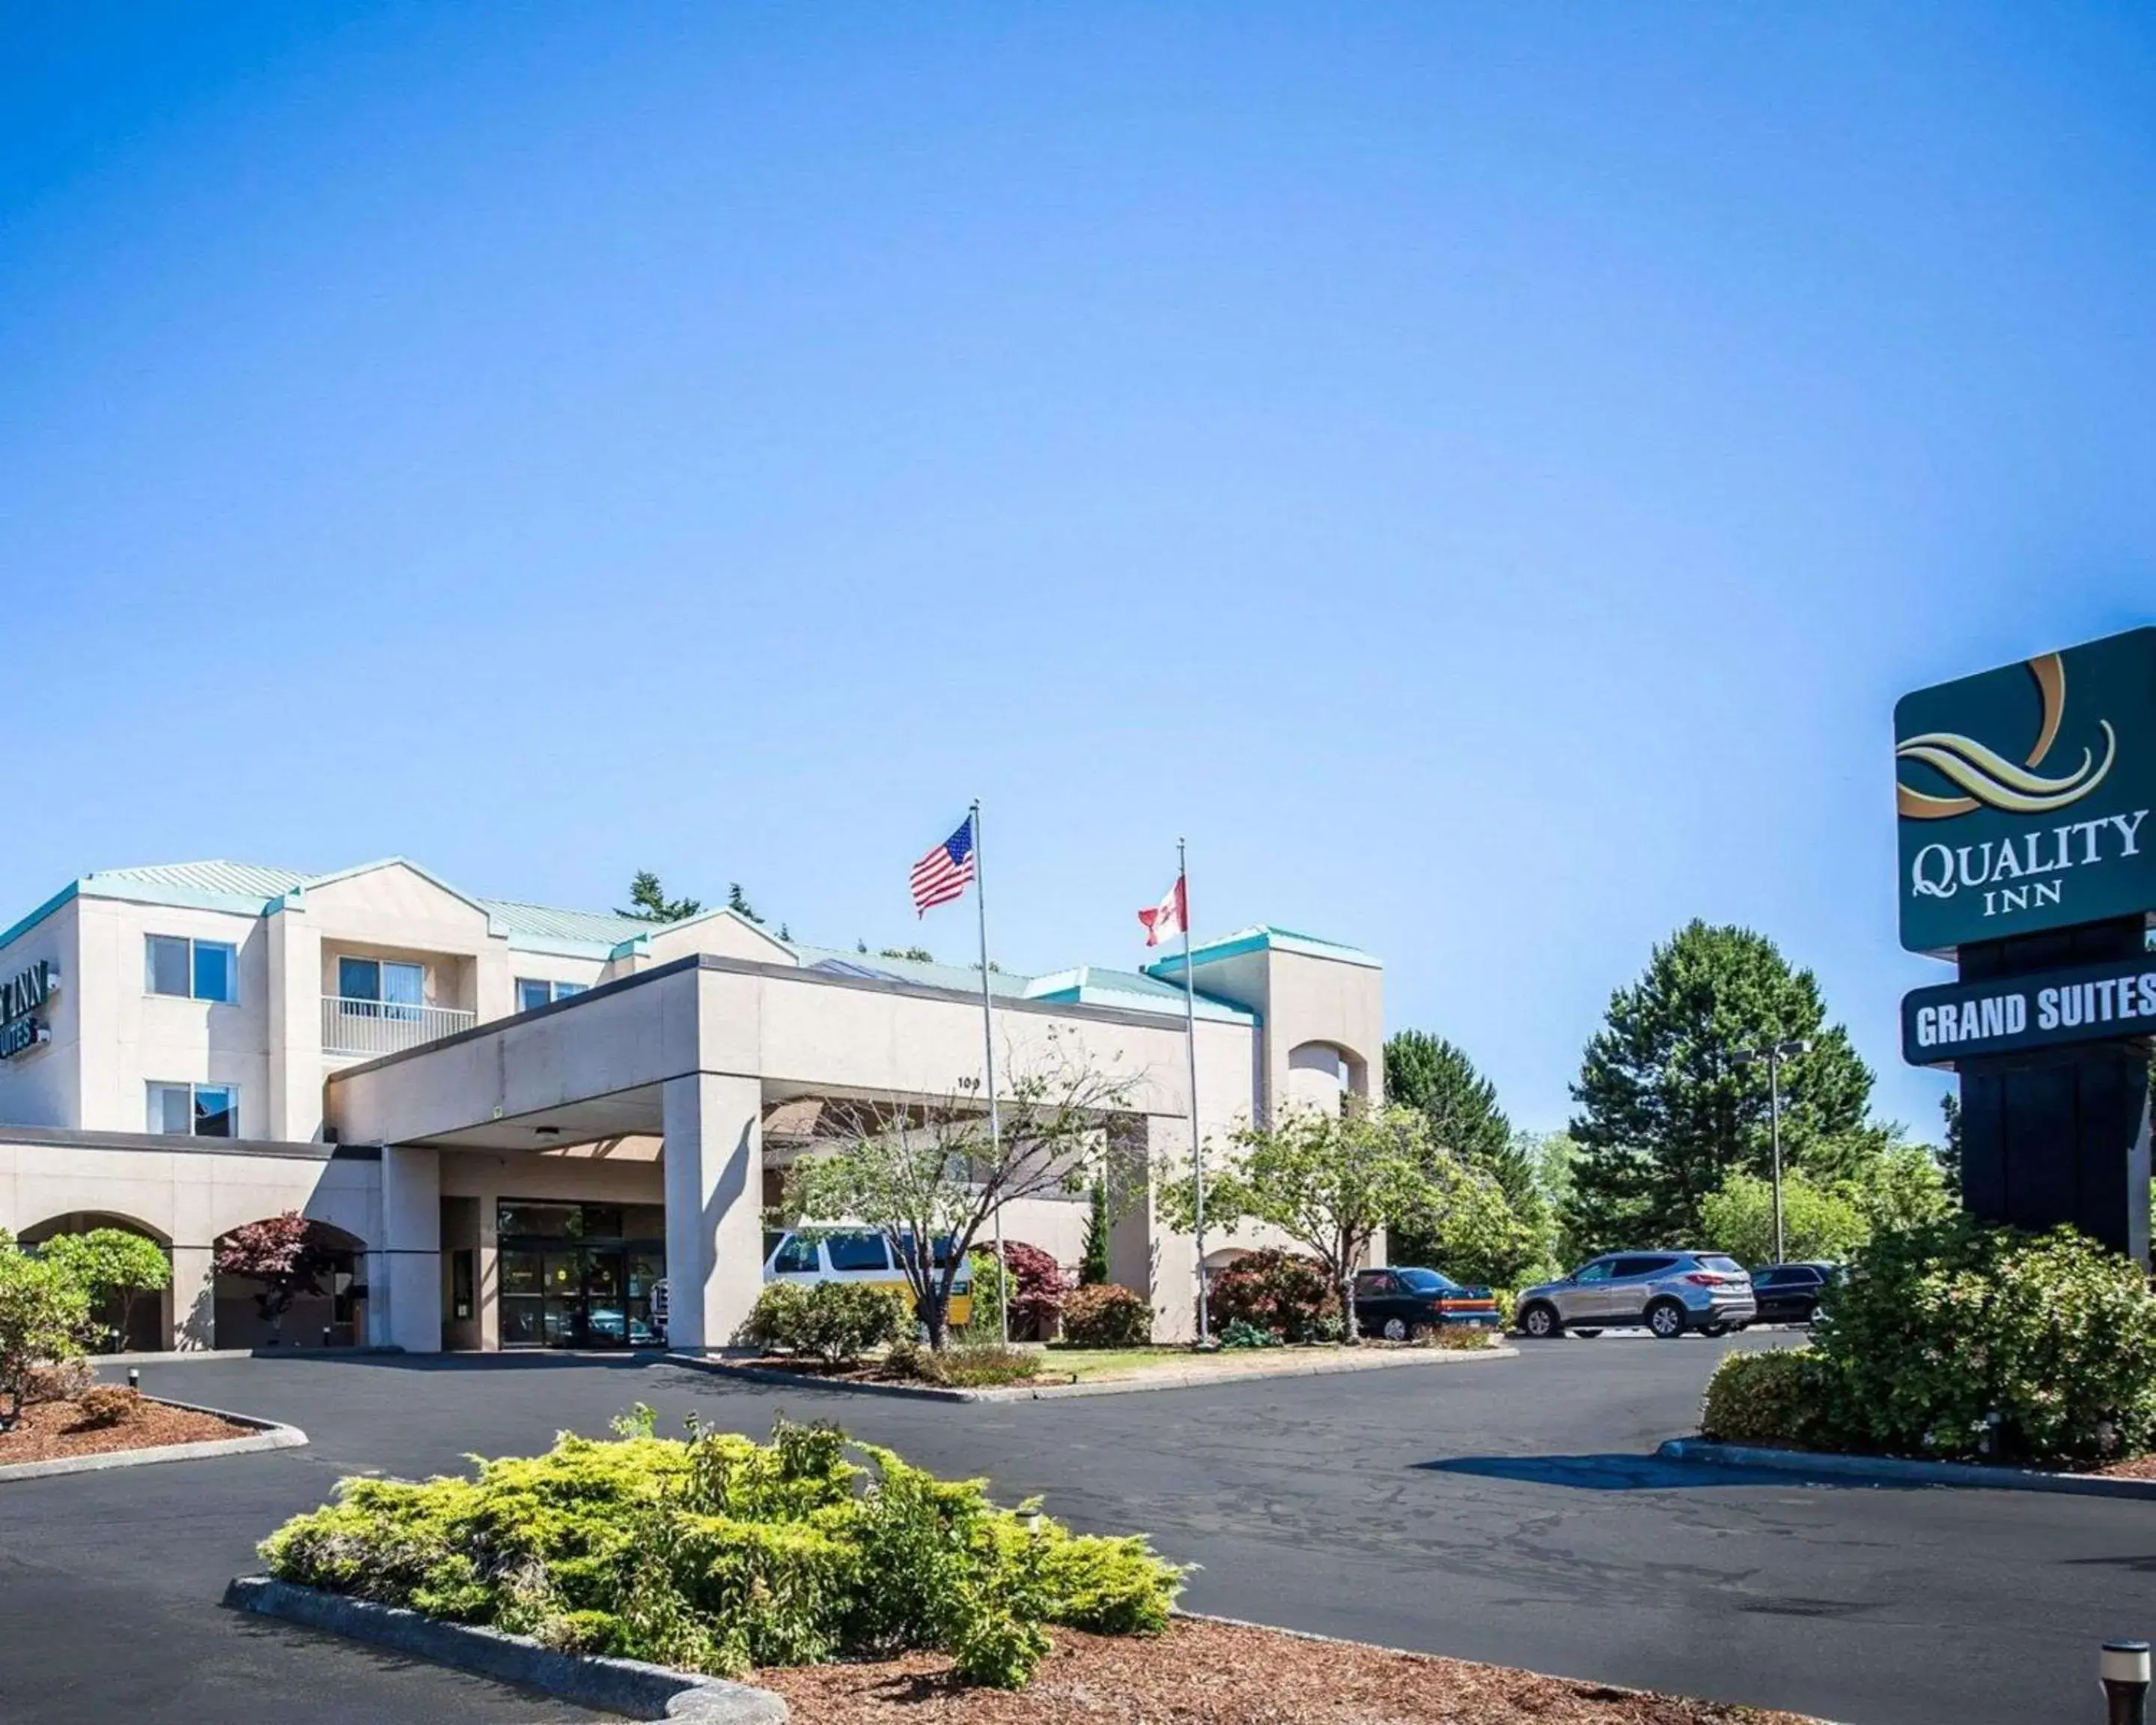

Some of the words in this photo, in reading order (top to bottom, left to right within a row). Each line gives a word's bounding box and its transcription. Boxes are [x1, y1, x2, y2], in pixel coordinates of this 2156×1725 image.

[1912, 809, 2149, 898] QUALITY
[1983, 879, 2063, 916] INN
[1916, 994, 2026, 1047] GRAND
[2038, 973, 2156, 1031] SUITES
